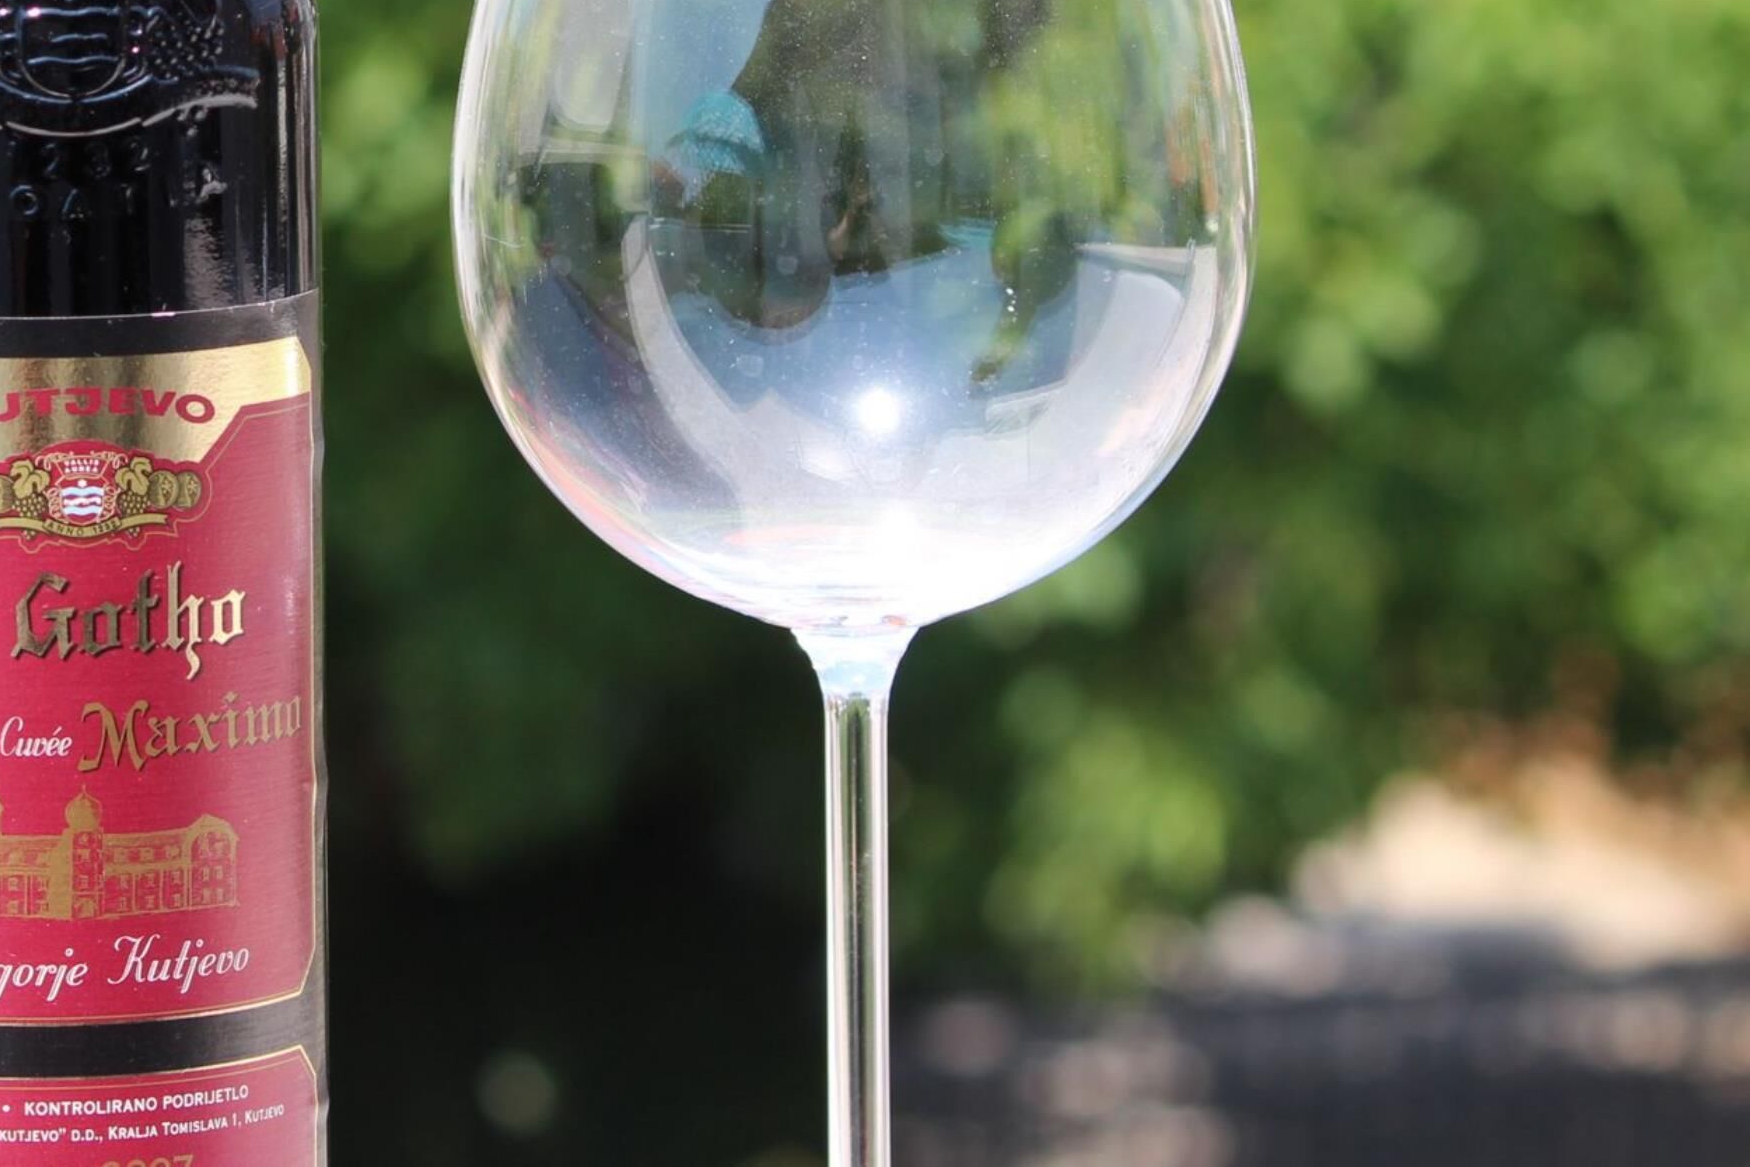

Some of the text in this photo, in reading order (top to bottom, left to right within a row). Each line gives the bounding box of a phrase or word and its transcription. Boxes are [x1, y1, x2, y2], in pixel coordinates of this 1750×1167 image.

[47, 521, 85, 535] ANNO
[11, 560, 246, 680] Gotho
[0, 716, 72, 756] Cuvée
[77, 691, 301, 772] Maximo
[107, 933, 250, 994] Kutjevo
[24, 1097, 158, 1117] KONTROLIRANO
[162, 1085, 249, 1111] PODRIJETLO
[70, 1128, 103, 1143] D.D.,
[108, 1125, 158, 1140] KRALJA
[162, 1116, 228, 1136] TOMISLAVA
[244, 1104, 285, 1124] KUTJEVO
